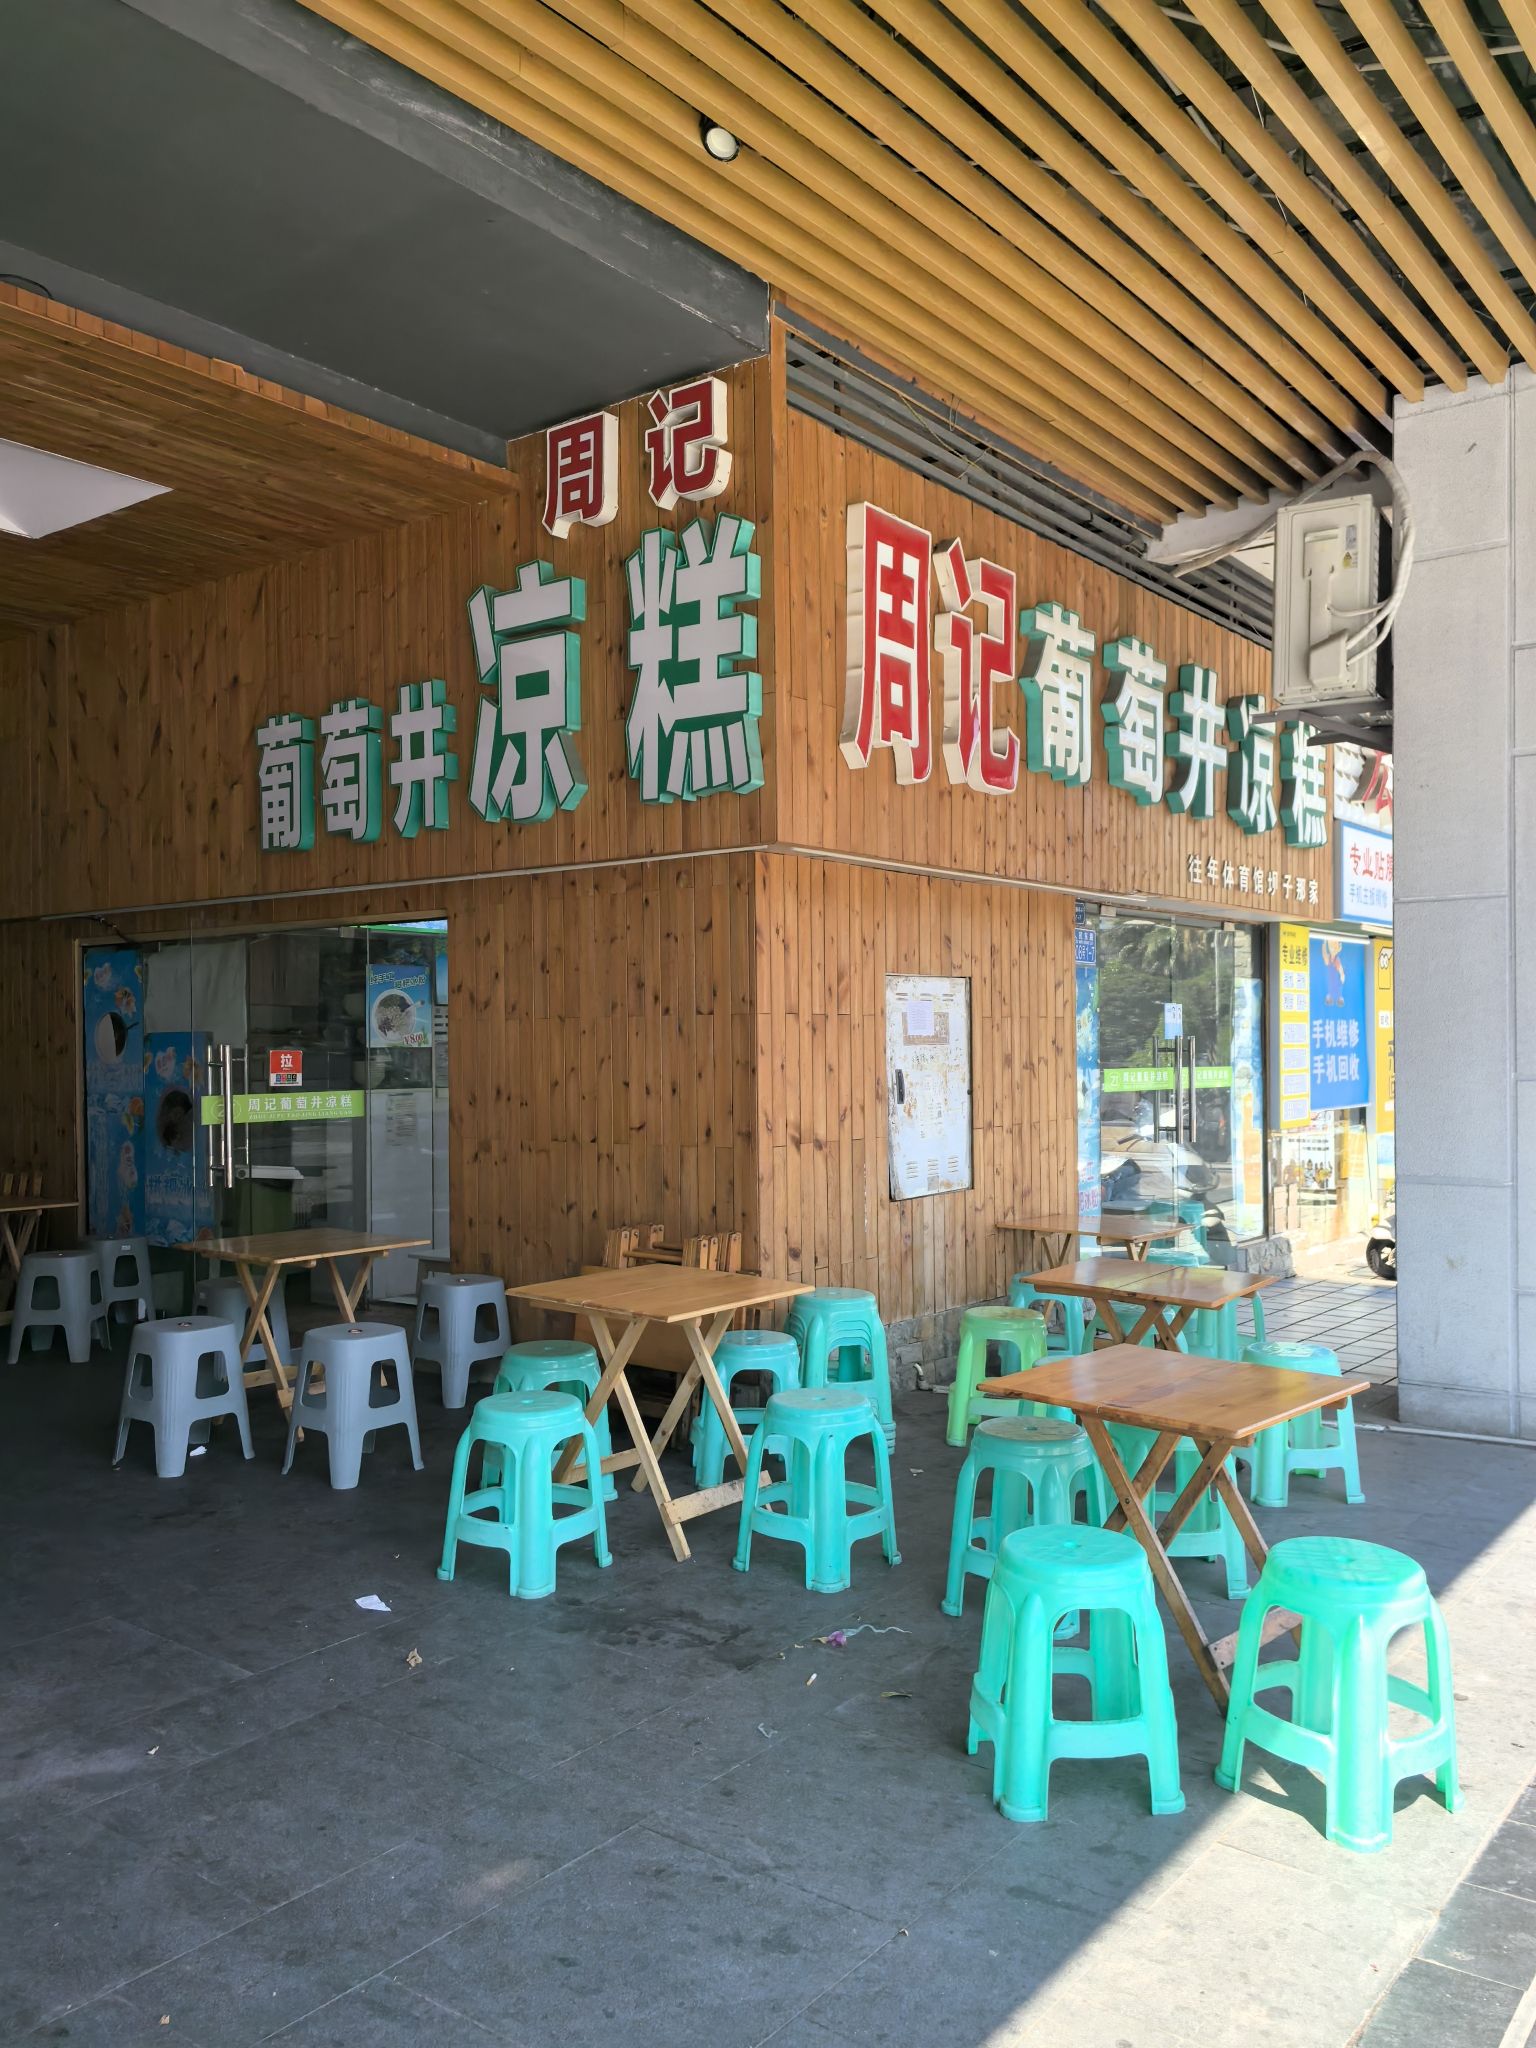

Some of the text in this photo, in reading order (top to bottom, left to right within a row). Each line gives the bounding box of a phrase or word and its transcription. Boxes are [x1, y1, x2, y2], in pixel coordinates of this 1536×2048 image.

[542, 376, 732, 538] 周记
[256, 513, 764, 854] 葡萄井凉糕
[1188, 854, 1319, 906] 往年体育馆坝子那家
[1312, 1018, 1359, 1048] 手机维修
[281, 1053, 293, 1068] 拉
[1313, 1052, 1360, 1084] 手机回收
[248, 1094, 353, 1112] 周记葡萄井凉糕
